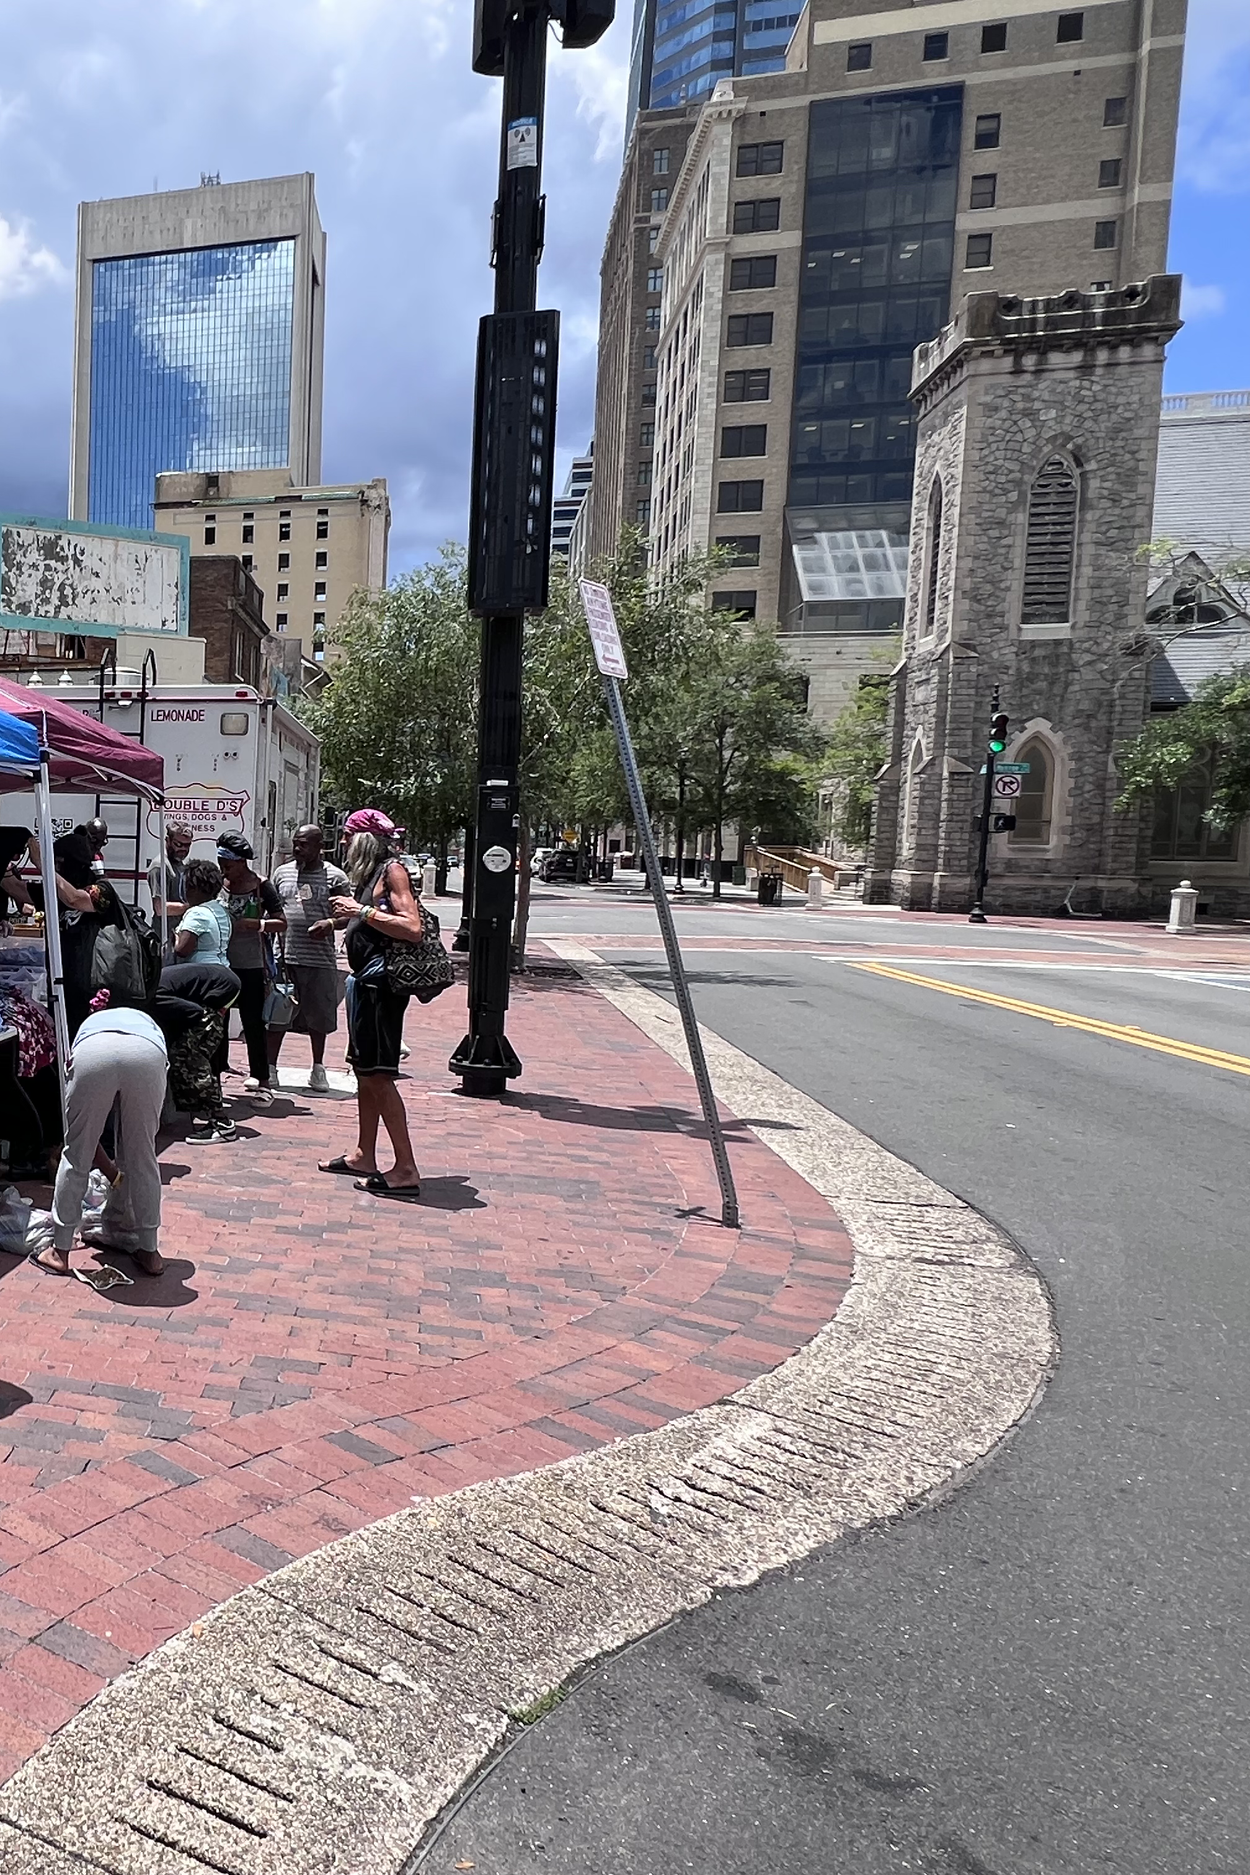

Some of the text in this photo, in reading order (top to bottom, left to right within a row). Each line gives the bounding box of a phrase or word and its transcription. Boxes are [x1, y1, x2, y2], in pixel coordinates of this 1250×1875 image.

[151, 709, 206, 722] LEMONADE
[216, 801, 238, 812] D'S
[164, 813, 190, 822] INGS,
[191, 813, 217, 821] DOGS
